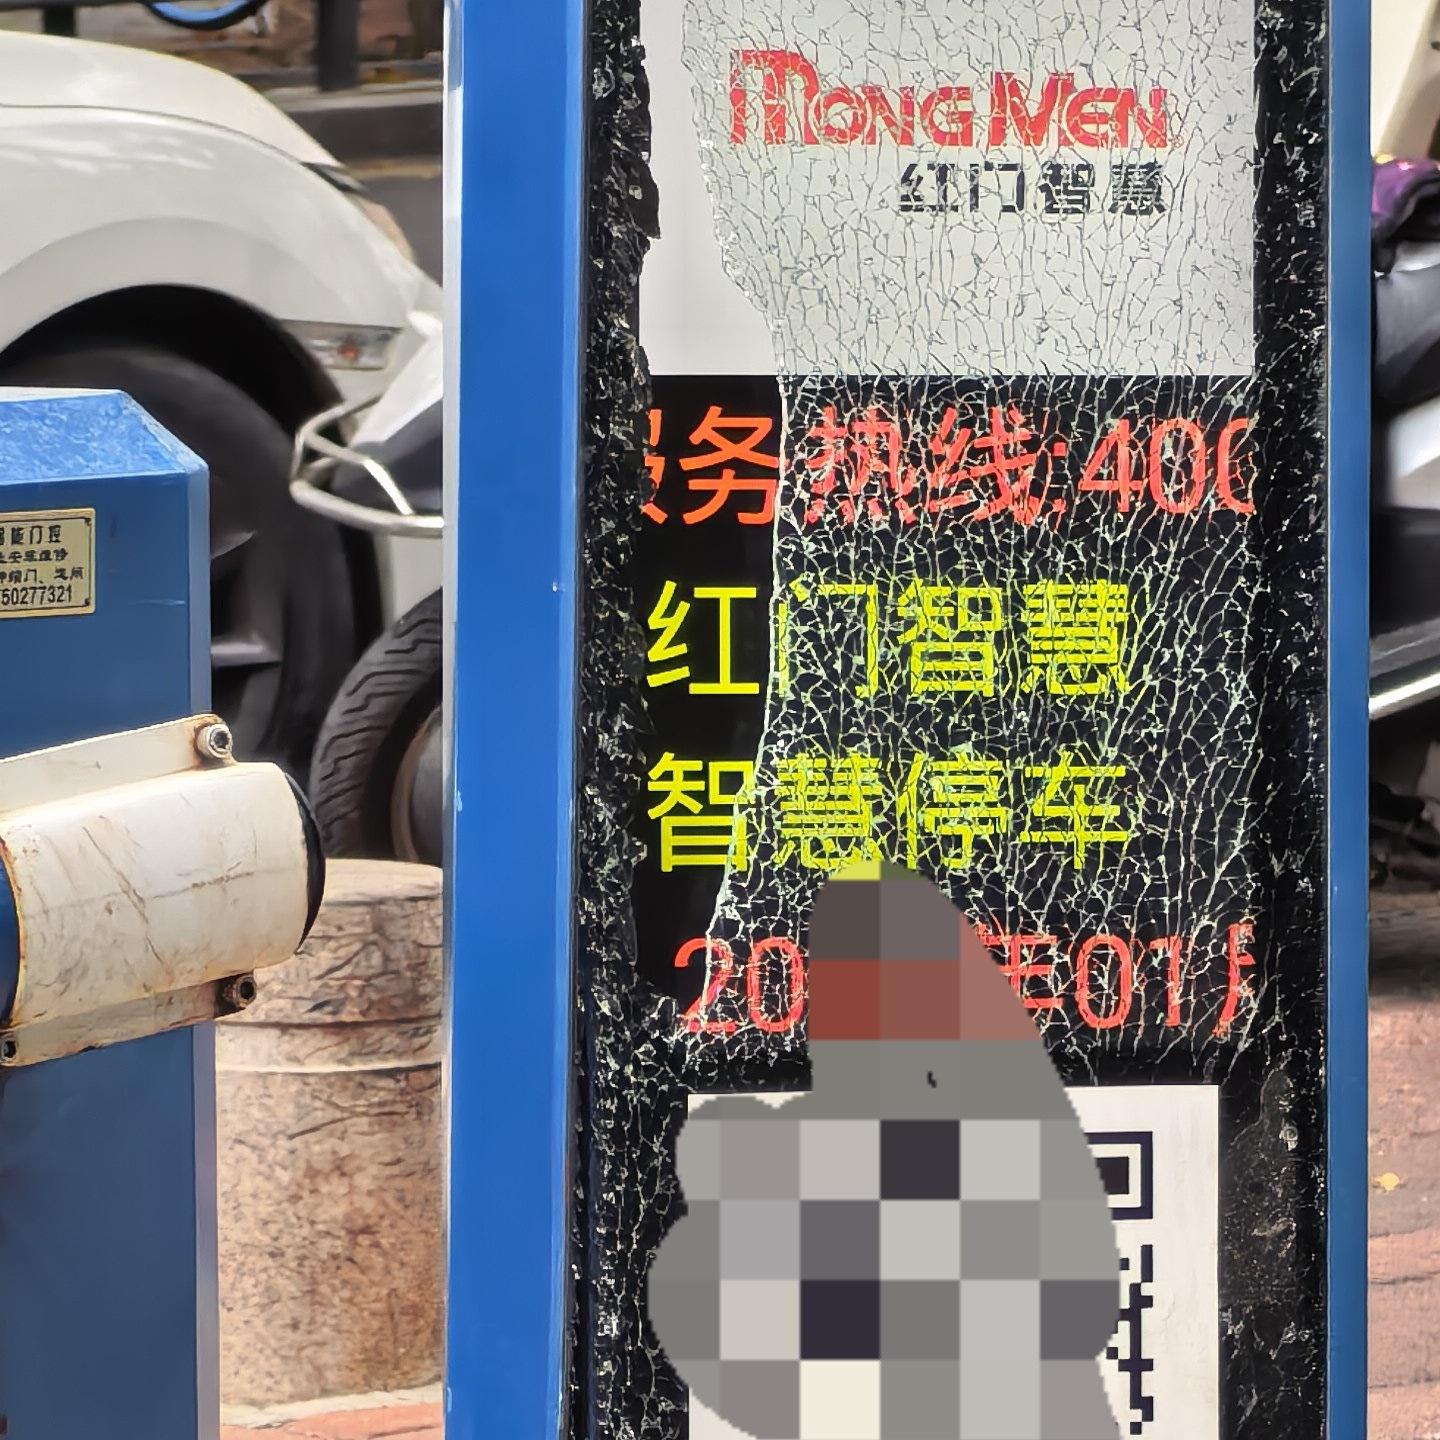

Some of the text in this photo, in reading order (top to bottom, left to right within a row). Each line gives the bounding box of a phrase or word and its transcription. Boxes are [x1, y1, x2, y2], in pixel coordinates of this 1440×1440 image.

[900, 163, 1167, 215] 红门智慧
[647, 579, 1130, 698] 红门智慧
[647, 750, 1130, 872] 智慧停车
